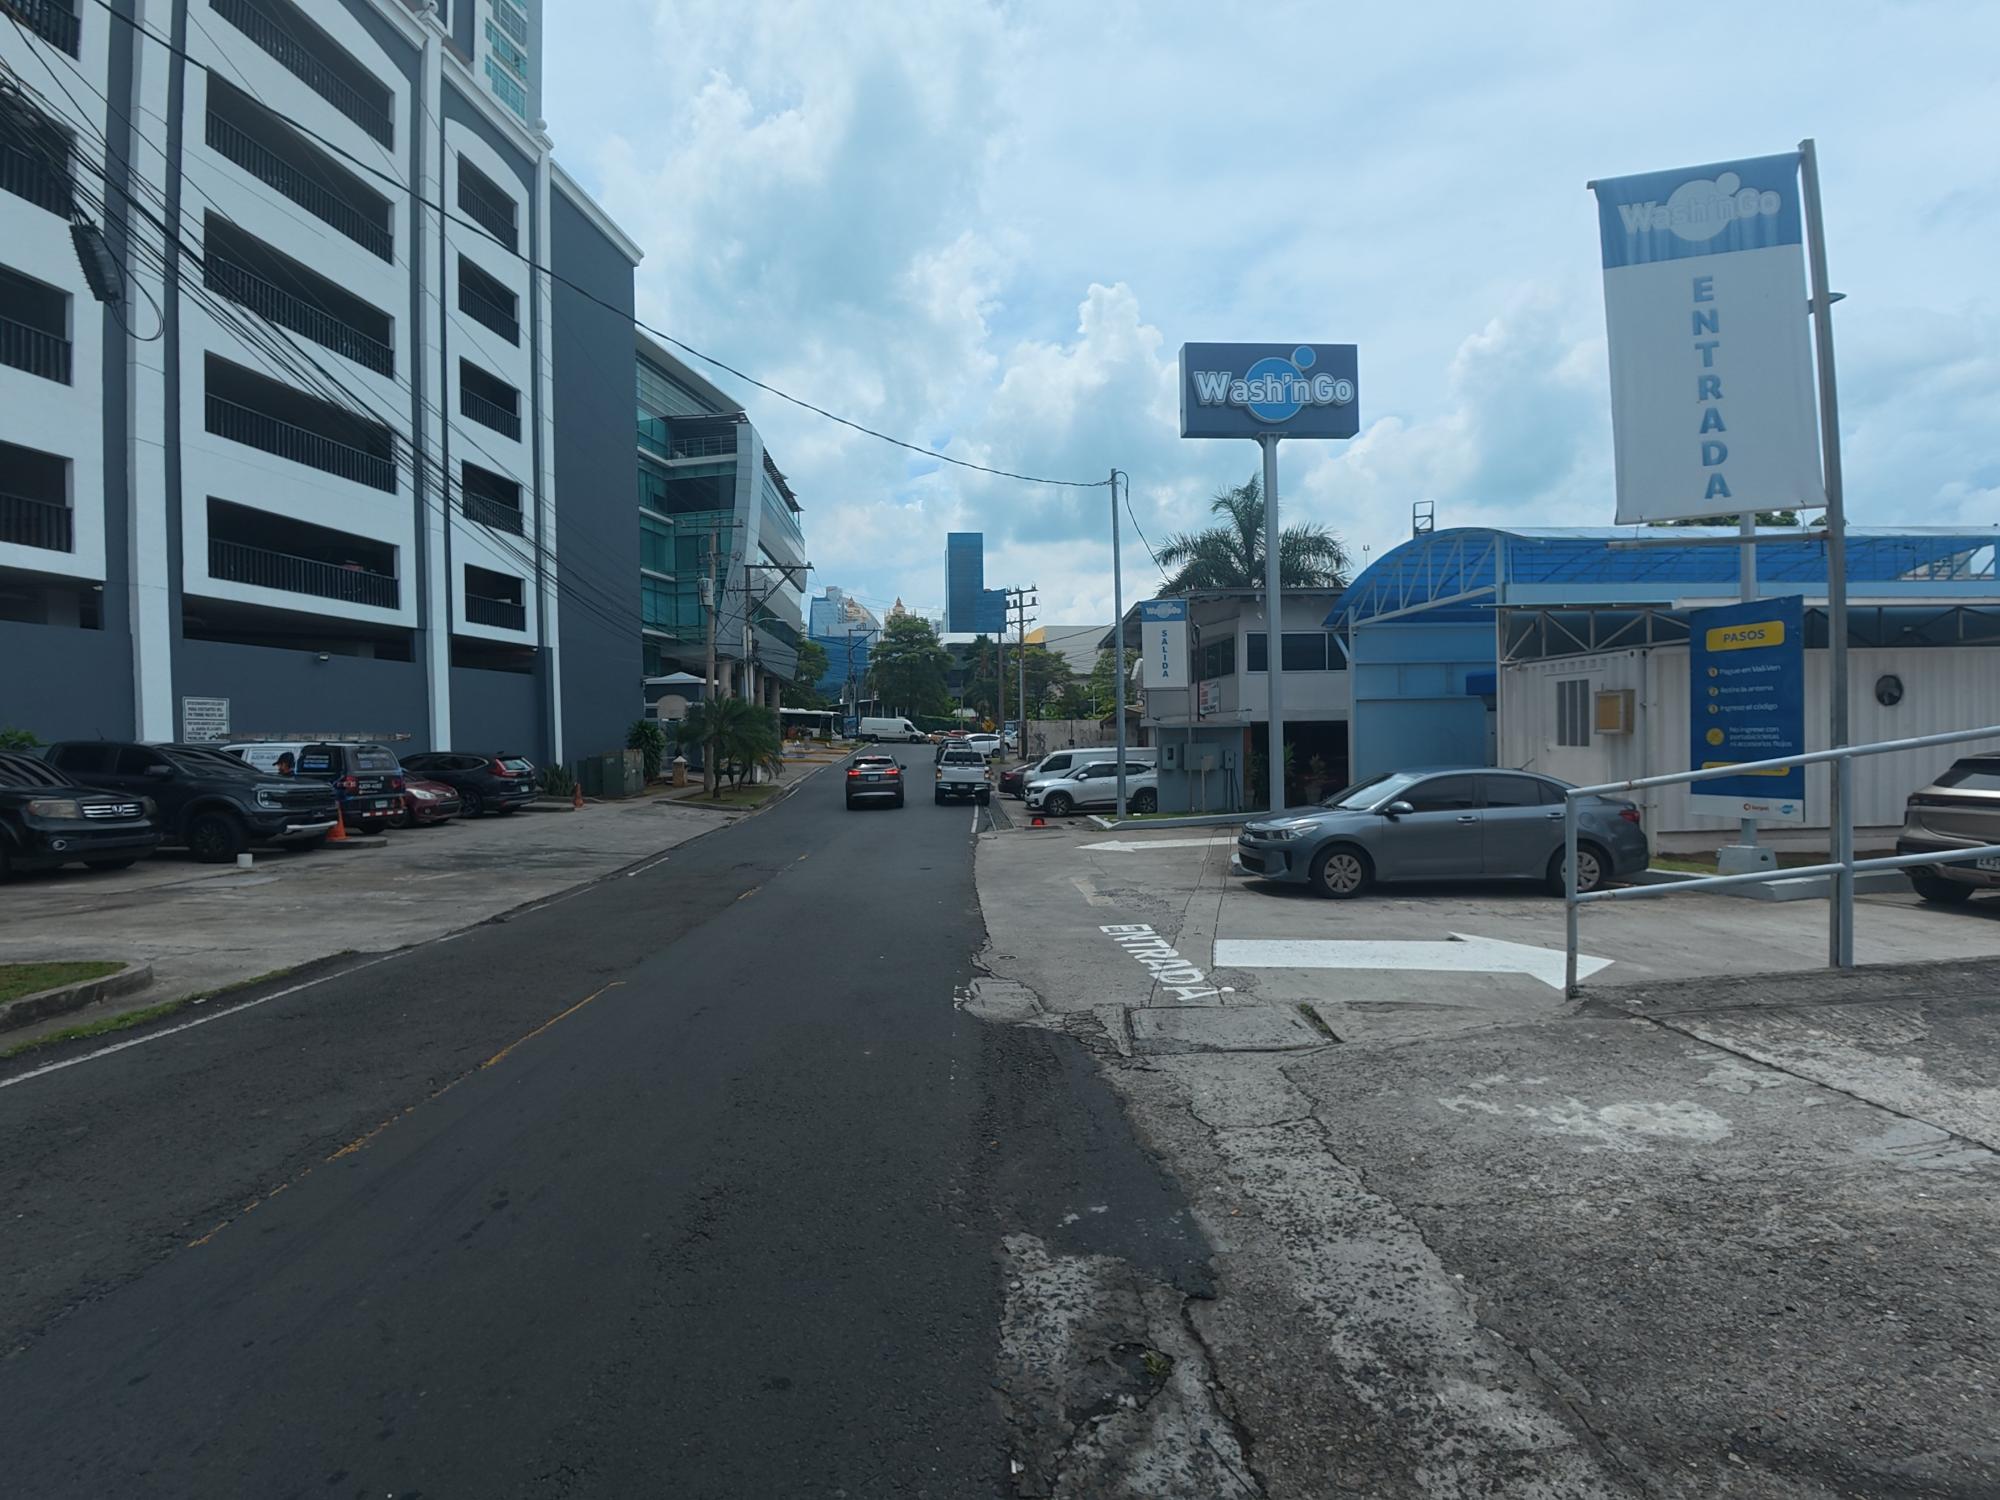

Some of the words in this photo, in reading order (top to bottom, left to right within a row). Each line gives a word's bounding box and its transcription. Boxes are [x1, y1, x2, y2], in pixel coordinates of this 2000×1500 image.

[1692, 275, 1732, 500] ENTRADA
[1161, 629, 1169, 678] SALIDA
[1723, 629, 1765, 643] PASOS
[1099, 923, 1226, 1001] ENTRADA
